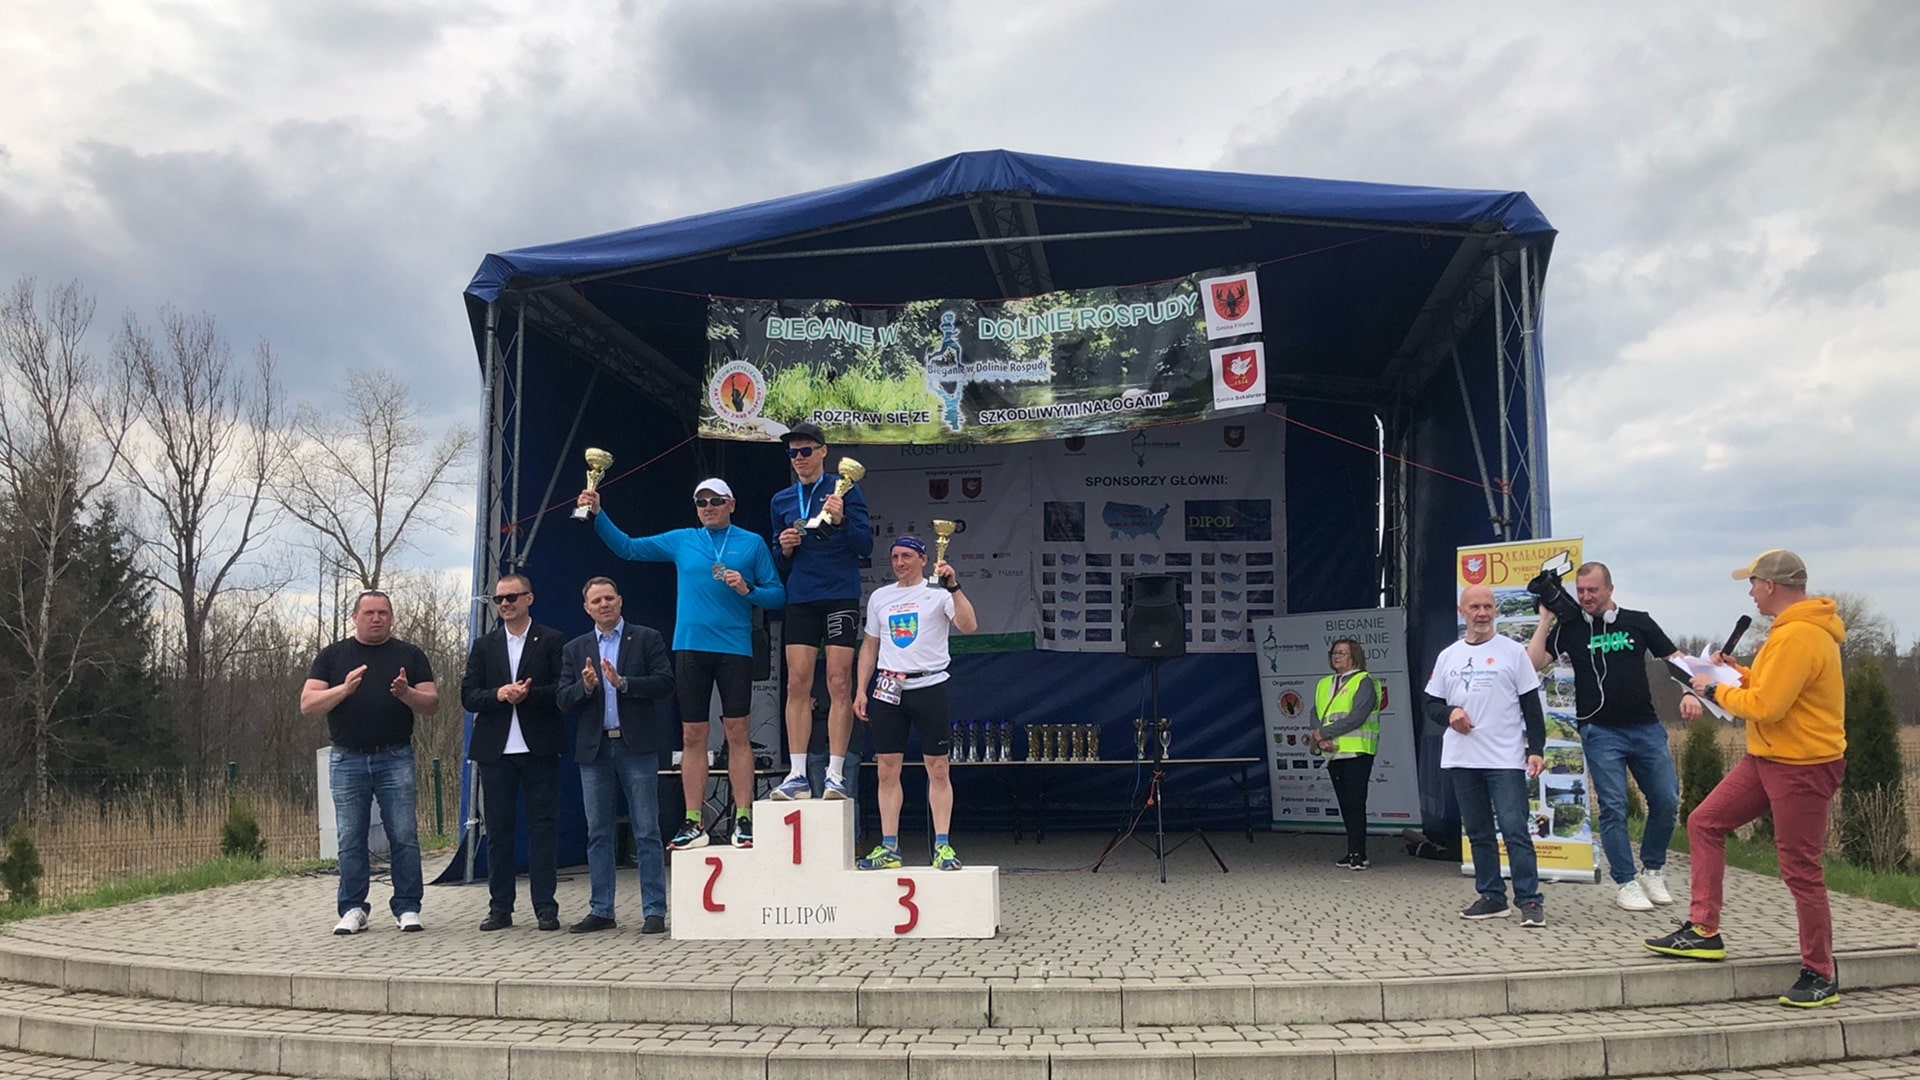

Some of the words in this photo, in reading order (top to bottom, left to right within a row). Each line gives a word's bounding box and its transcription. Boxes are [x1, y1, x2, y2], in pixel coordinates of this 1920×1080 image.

[979, 309, 1073, 339] DOLINIE
[1078, 293, 1198, 329] ROSPUDY
[767, 317, 875, 347] BIEGANIE
[878, 323, 899, 346] W
[927, 364, 964, 376] Bieganie
[976, 362, 1008, 373] Dolinie
[1010, 360, 1048, 373] Rospudy
[886, 412, 910, 426] SIĘ
[913, 410, 931, 424] ZE
[978, 403, 1080, 425] SZKODLIWYMI
[901, 443, 979, 457] ROSPUDY
[1085, 475, 1167, 487] SPONSORZY
[1170, 473, 1229, 486] GŁÓWNI:
[1188, 515, 1234, 528] DIPOL
[1325, 617, 1385, 632] BIEGANIE
[1323, 635, 1336, 647] W
[875, 676, 896, 693] 102
[784, 809, 802, 864] 1
[702, 856, 726, 912] 2
[761, 903, 838, 925] FILIPÓW
[894, 877, 919, 934] 3
